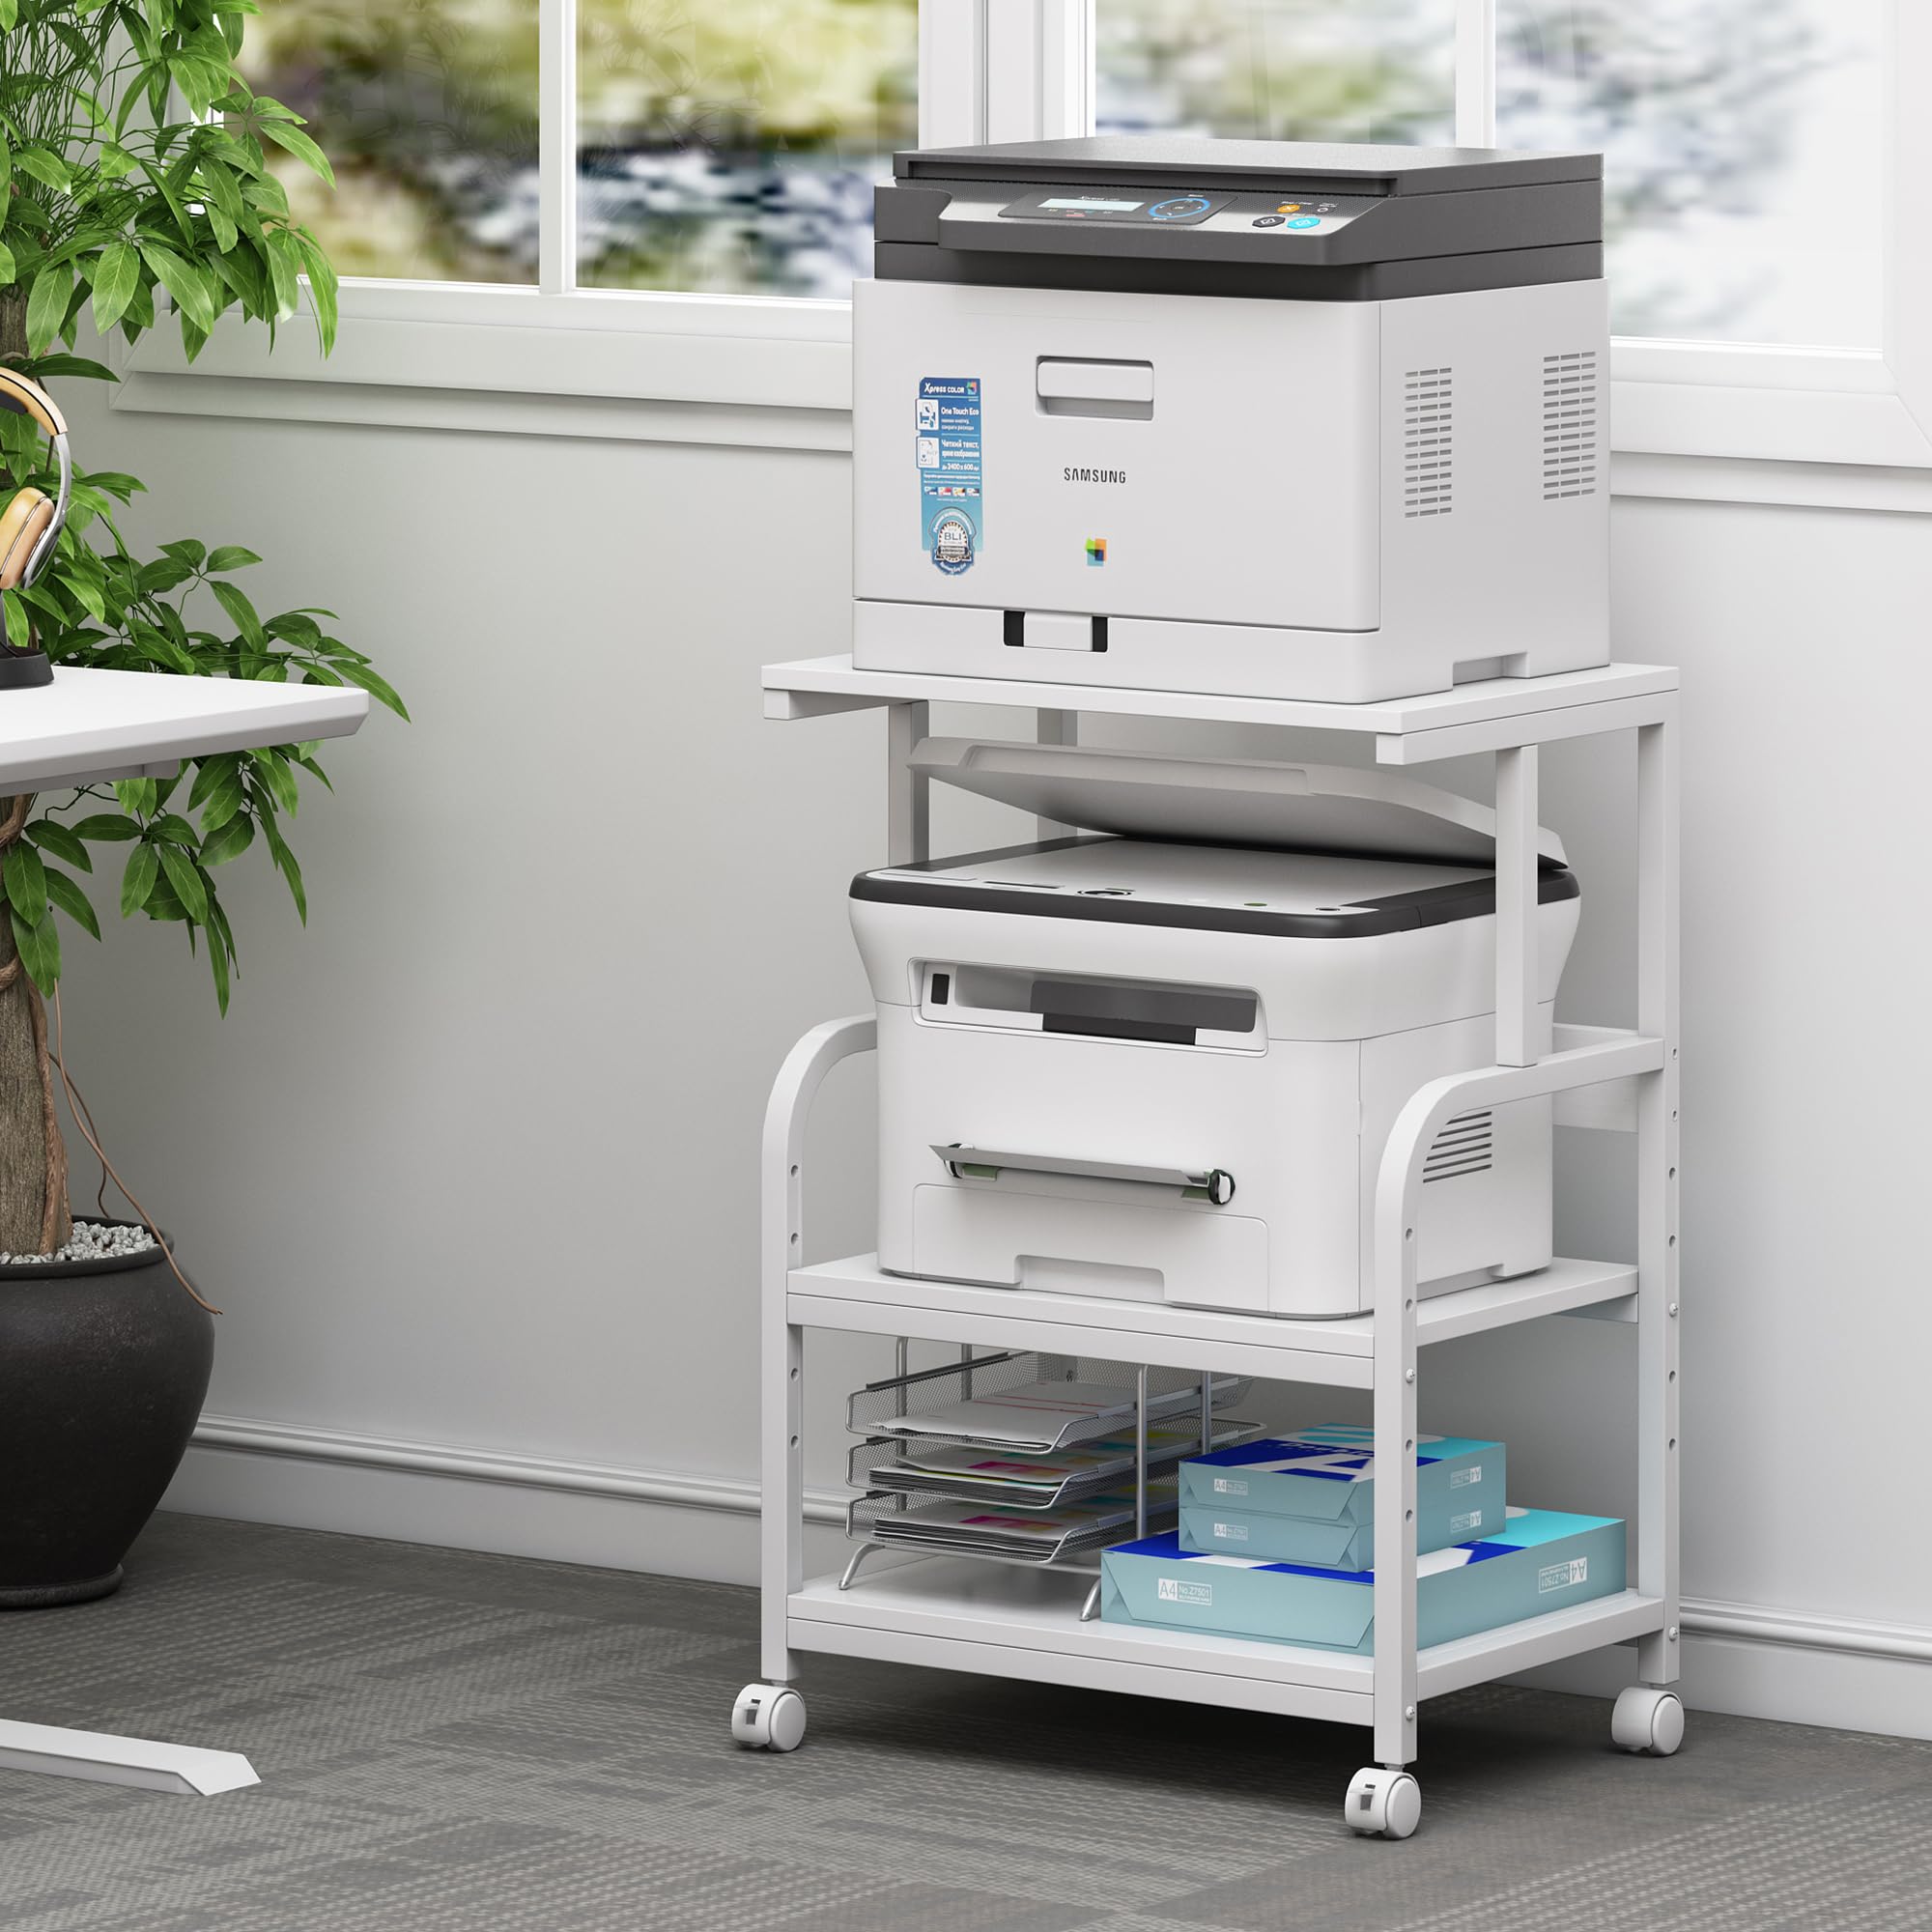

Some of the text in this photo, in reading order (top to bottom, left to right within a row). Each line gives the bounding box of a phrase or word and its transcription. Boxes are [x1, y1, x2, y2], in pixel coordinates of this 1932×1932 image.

[924, 383, 947, 394] Xpress
[941, 407, 980, 415] One Touch Eco
[1064, 467, 1126, 484] SAMSUNG
[944, 531, 962, 541] BLI
[1215, 1480, 1227, 1492] A4
[1215, 1523, 1227, 1536] A4
[1571, 1559, 1586, 1582] A4
[1159, 1579, 1176, 1599] A4
